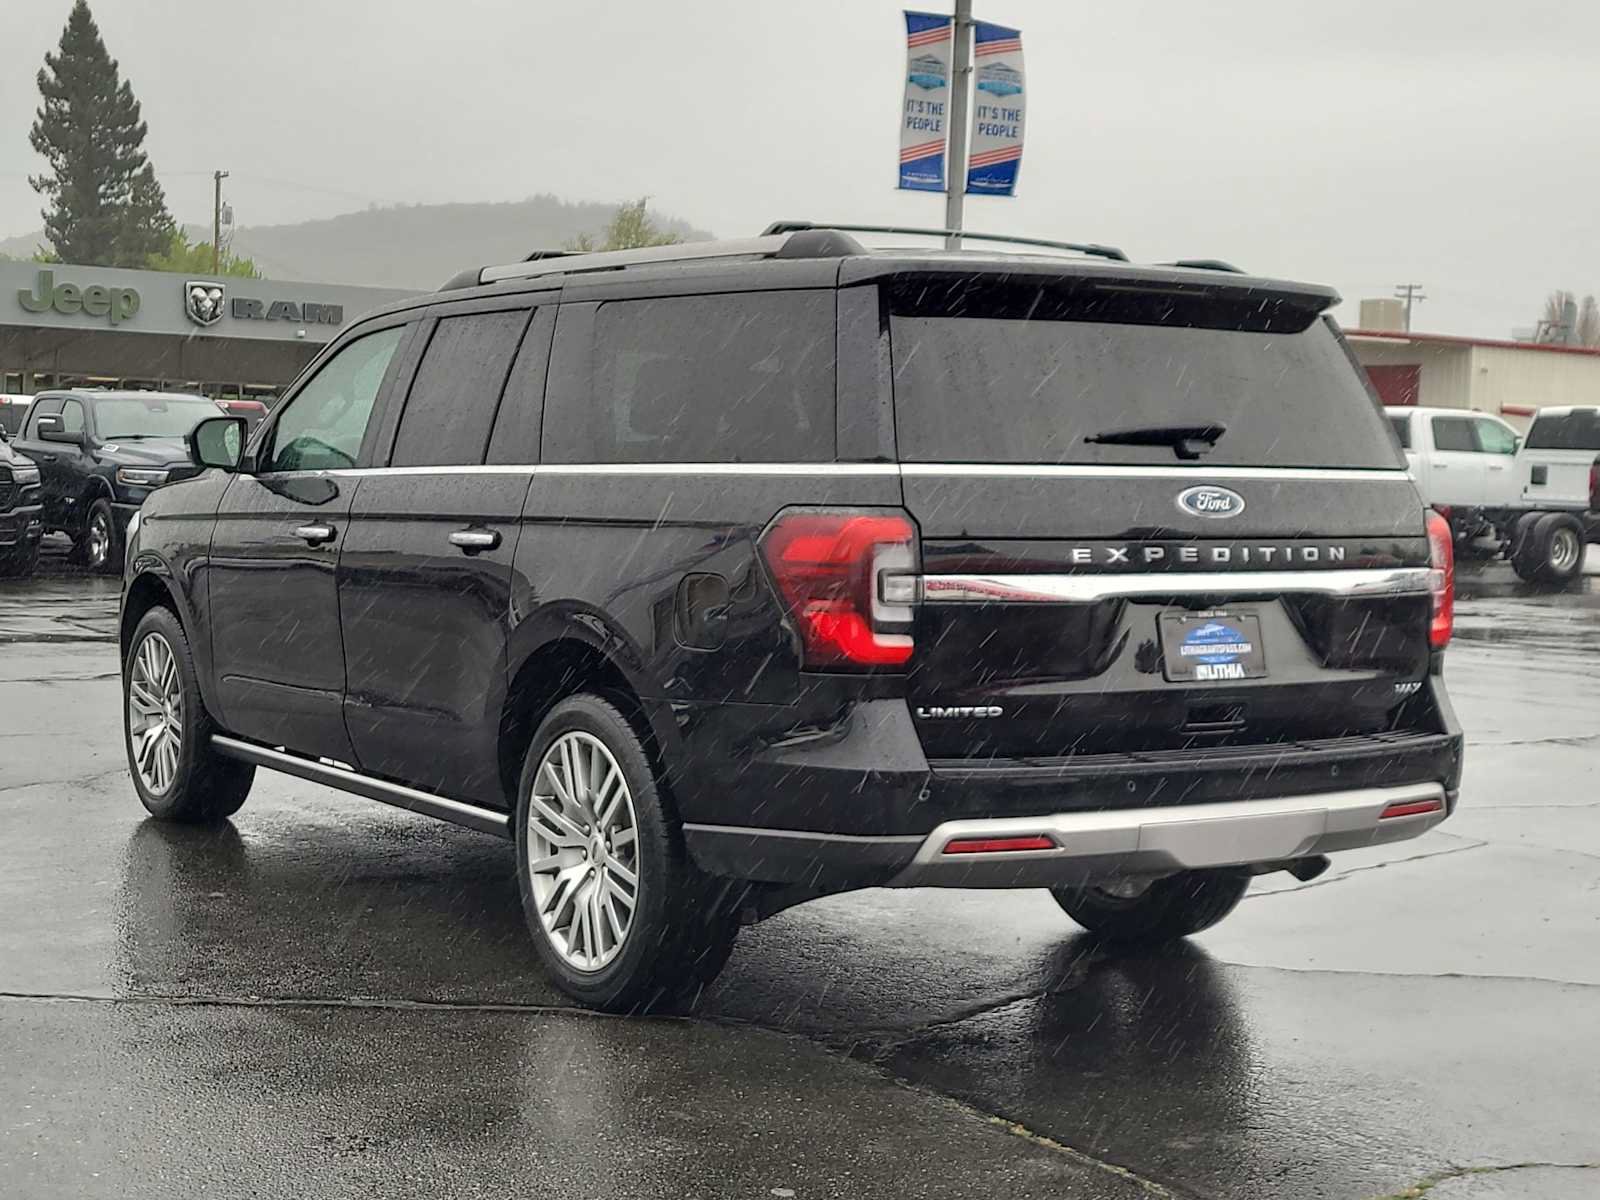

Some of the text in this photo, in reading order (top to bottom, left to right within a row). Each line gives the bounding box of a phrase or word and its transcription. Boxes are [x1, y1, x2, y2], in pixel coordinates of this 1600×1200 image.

[906, 99, 944, 116] IT'S THE
[977, 105, 1022, 122] IT'S THE
[906, 116, 942, 132] PEOPLE
[978, 122, 1018, 138] PEOPLE
[17, 270, 140, 325] Jeep
[232, 297, 344, 325] RAM
[1196, 490, 1232, 512] Ford
[1072, 546, 1346, 564] EXPEDITION
[1207, 663, 1245, 680] LITHIA
[916, 705, 1004, 718] LIMITED
